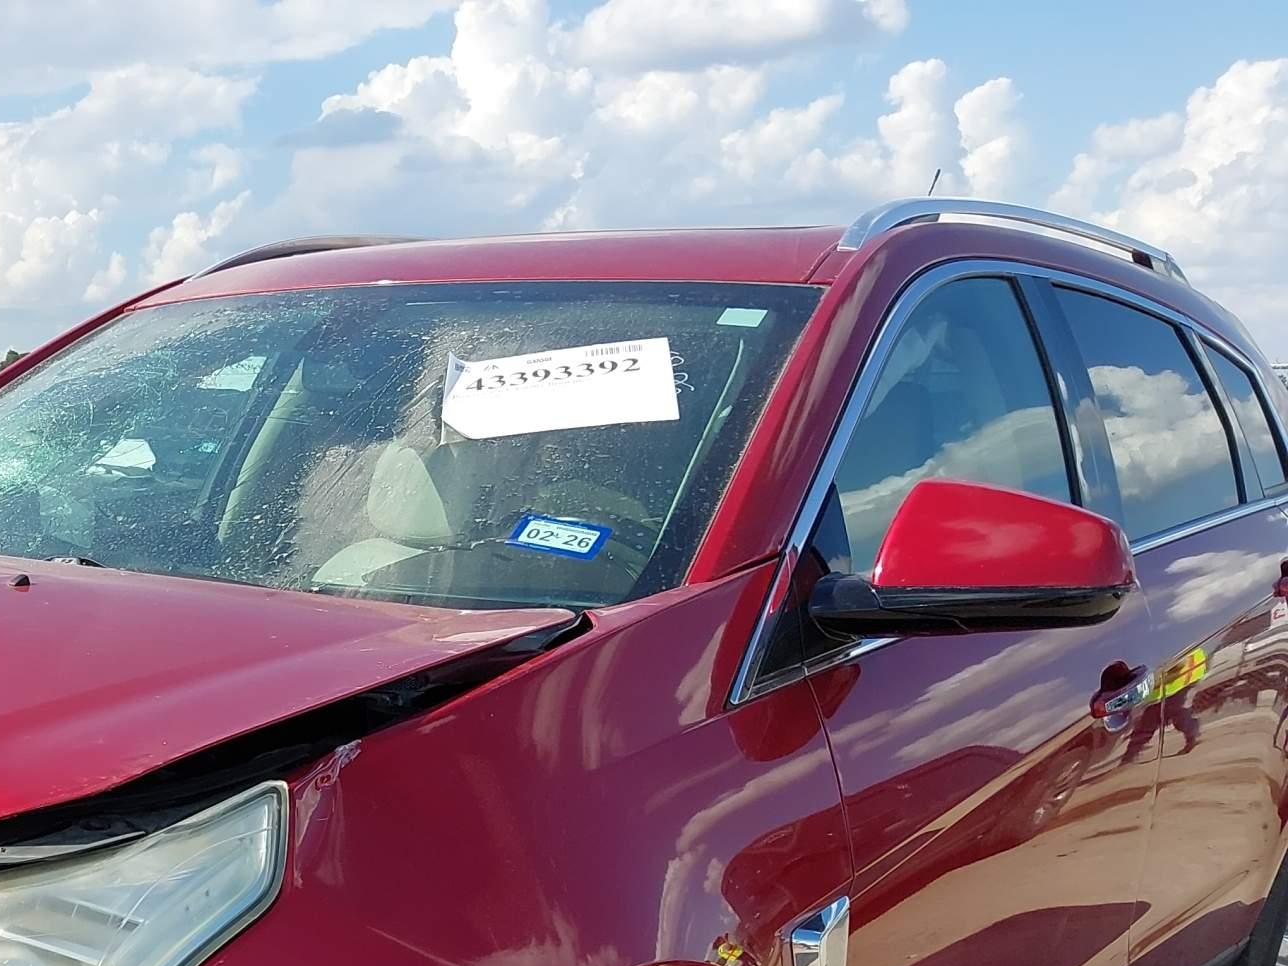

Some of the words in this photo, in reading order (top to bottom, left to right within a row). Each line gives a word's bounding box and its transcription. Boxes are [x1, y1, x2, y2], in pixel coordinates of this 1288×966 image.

[465, 357, 641, 391] 43393392
[526, 528, 554, 542] 02
[562, 534, 591, 548] 26
